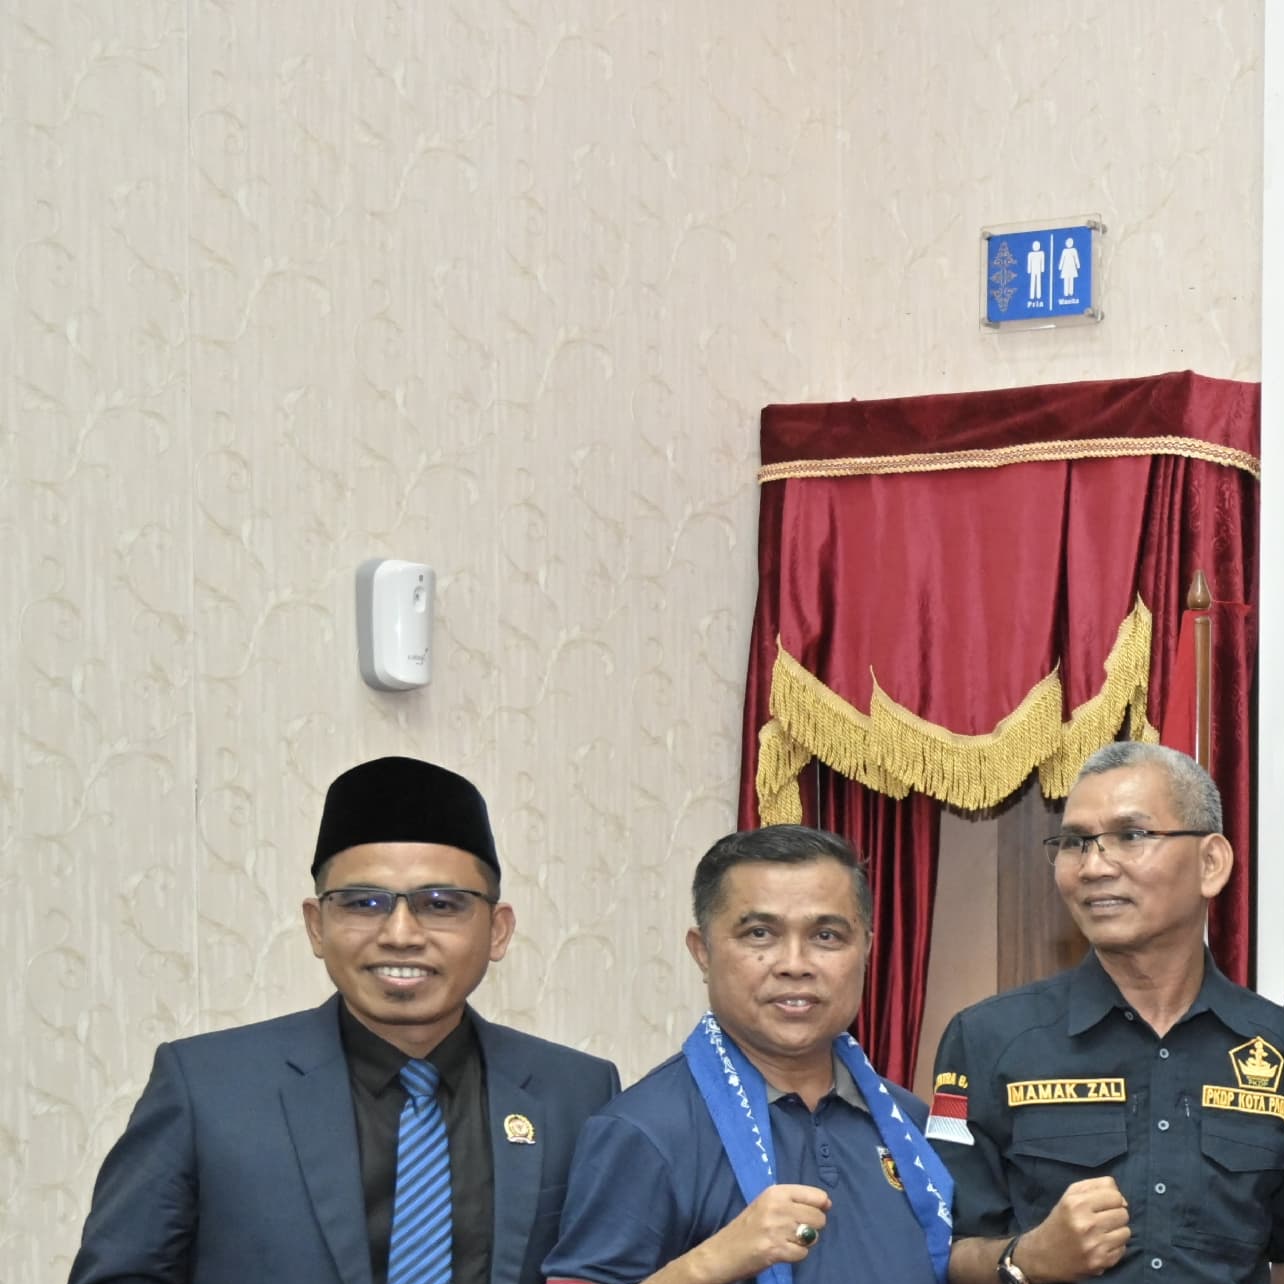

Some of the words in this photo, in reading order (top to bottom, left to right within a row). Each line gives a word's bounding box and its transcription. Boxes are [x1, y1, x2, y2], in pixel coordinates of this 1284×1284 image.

[1011, 1083, 1077, 1103] MAMAK
[1087, 1082, 1121, 1098] ZAL
[1206, 1088, 1235, 1107] PKDP
[1238, 1093, 1266, 1112] KOTA
